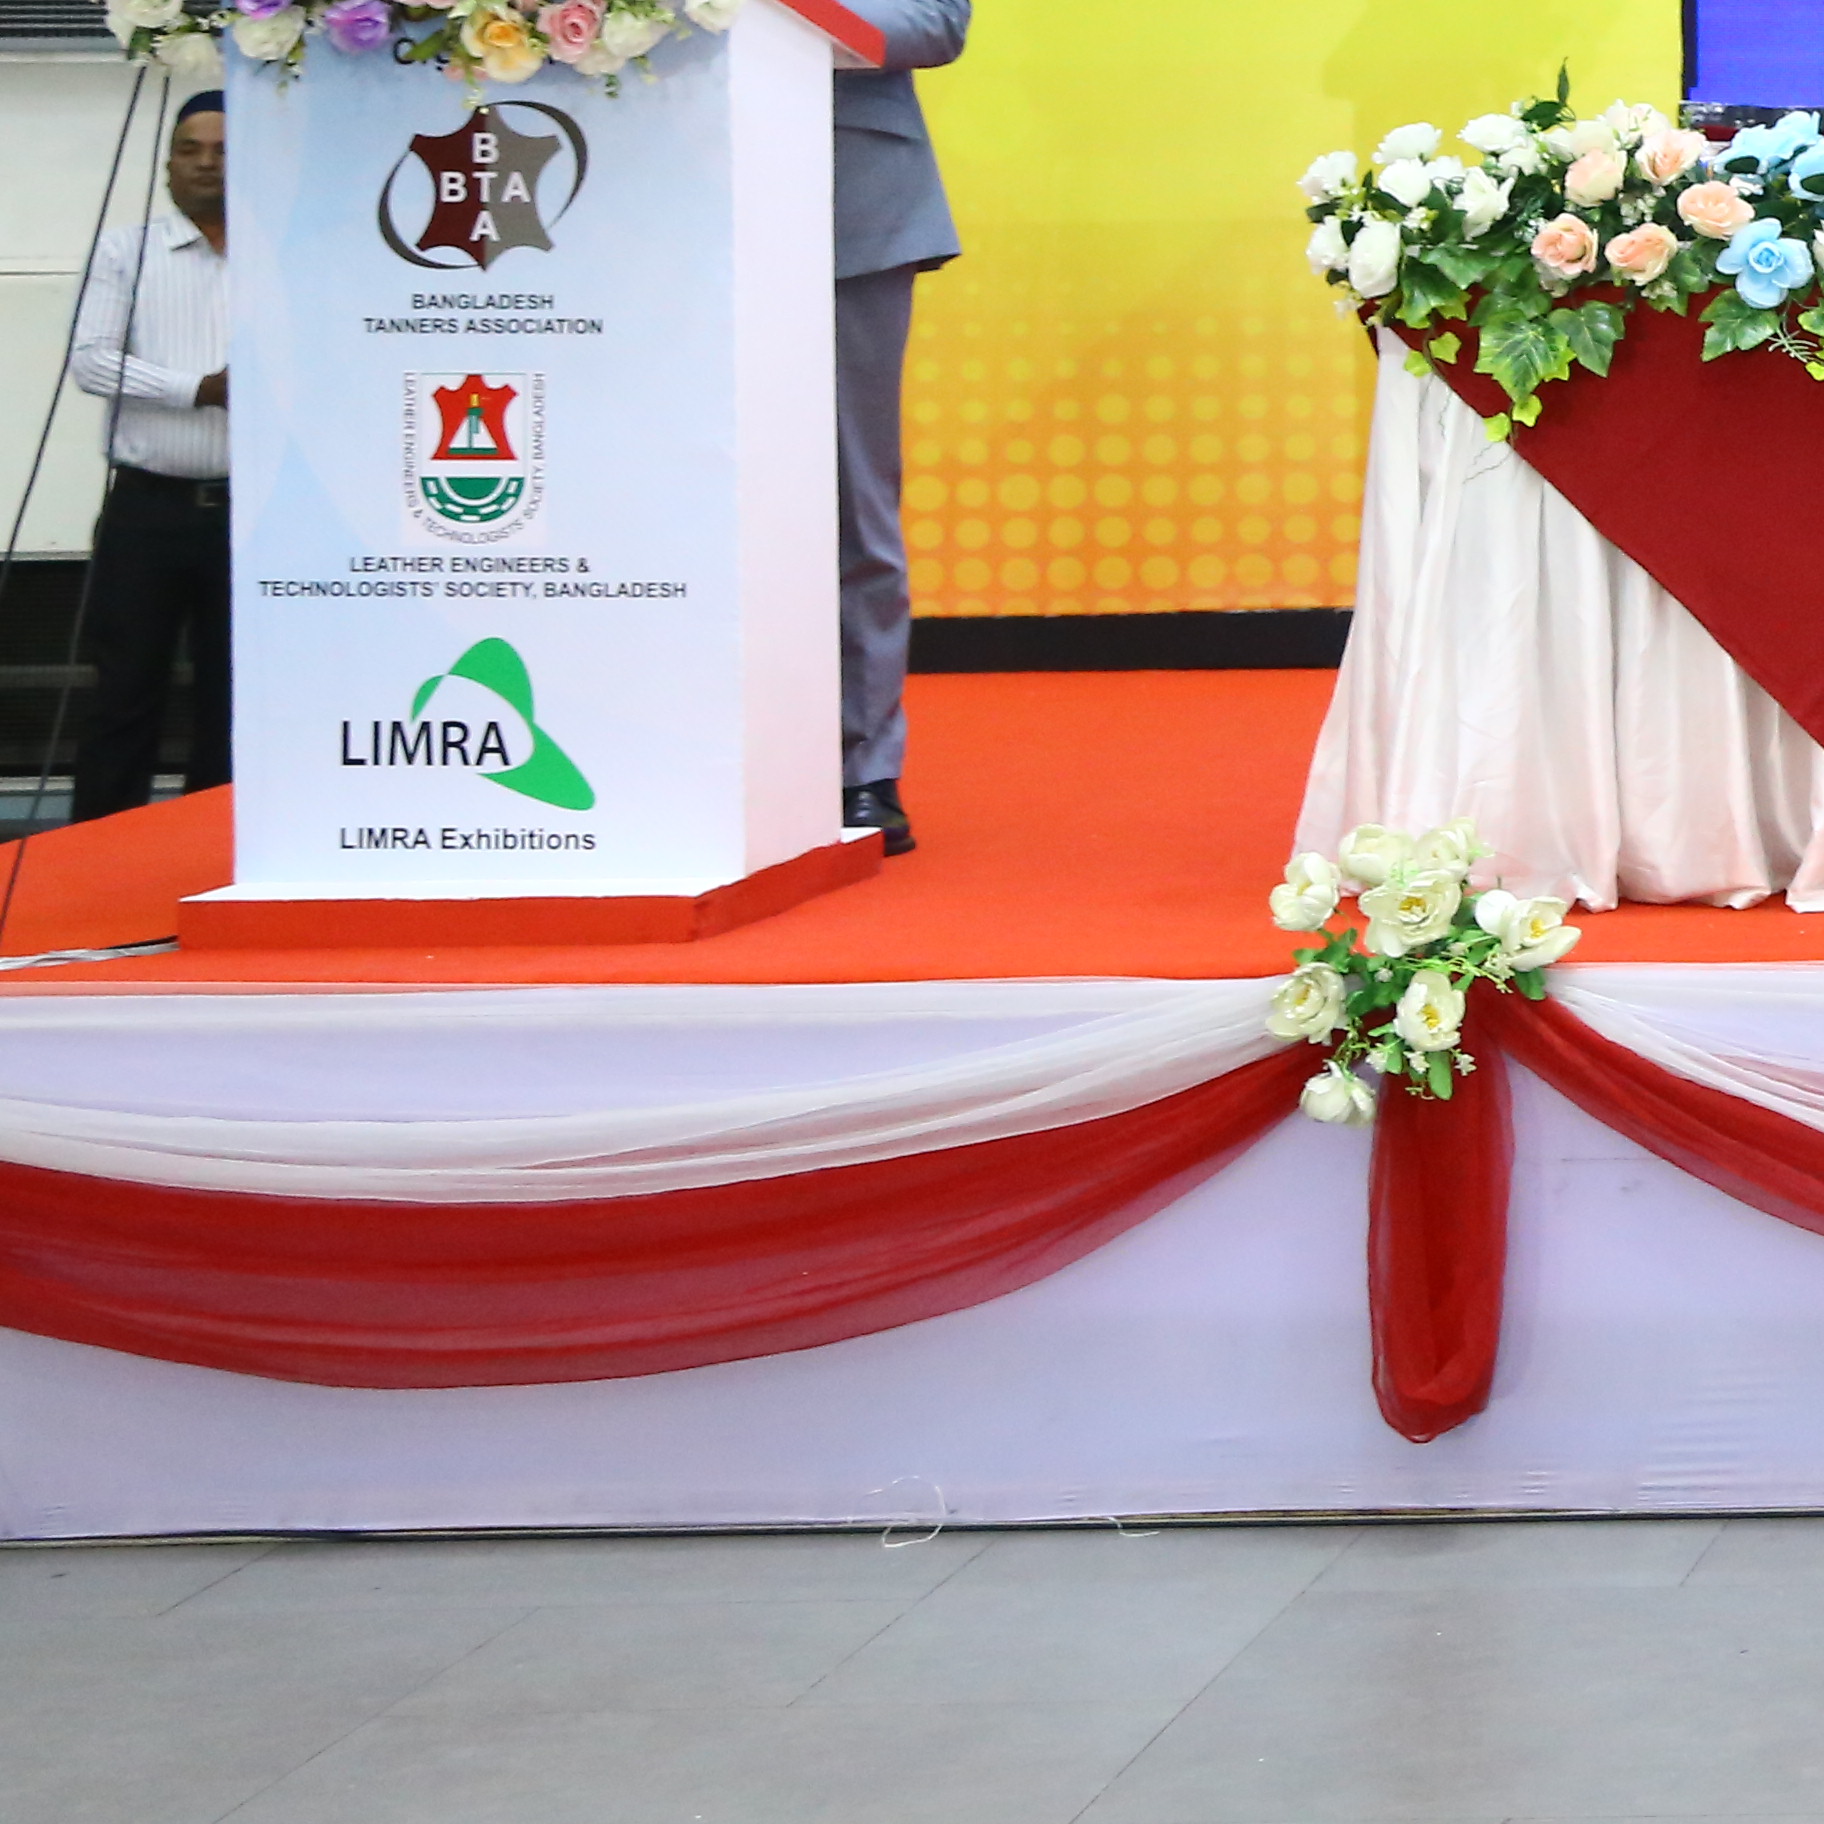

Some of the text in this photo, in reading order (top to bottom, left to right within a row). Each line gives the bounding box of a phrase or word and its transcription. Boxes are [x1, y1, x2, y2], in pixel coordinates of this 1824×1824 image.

[412, 293, 554, 310] BANGLADESH
[363, 317, 603, 335] TANNERS ASSOCIATION
[350, 556, 590, 574] LEATHER ENGINEERS &
[258, 580, 687, 600] TECHNOLOGISTS' SOCIETY, BANGLADESH
[341, 720, 511, 767] LIMRA
[340, 827, 596, 851] LIMRA Exhibitions
